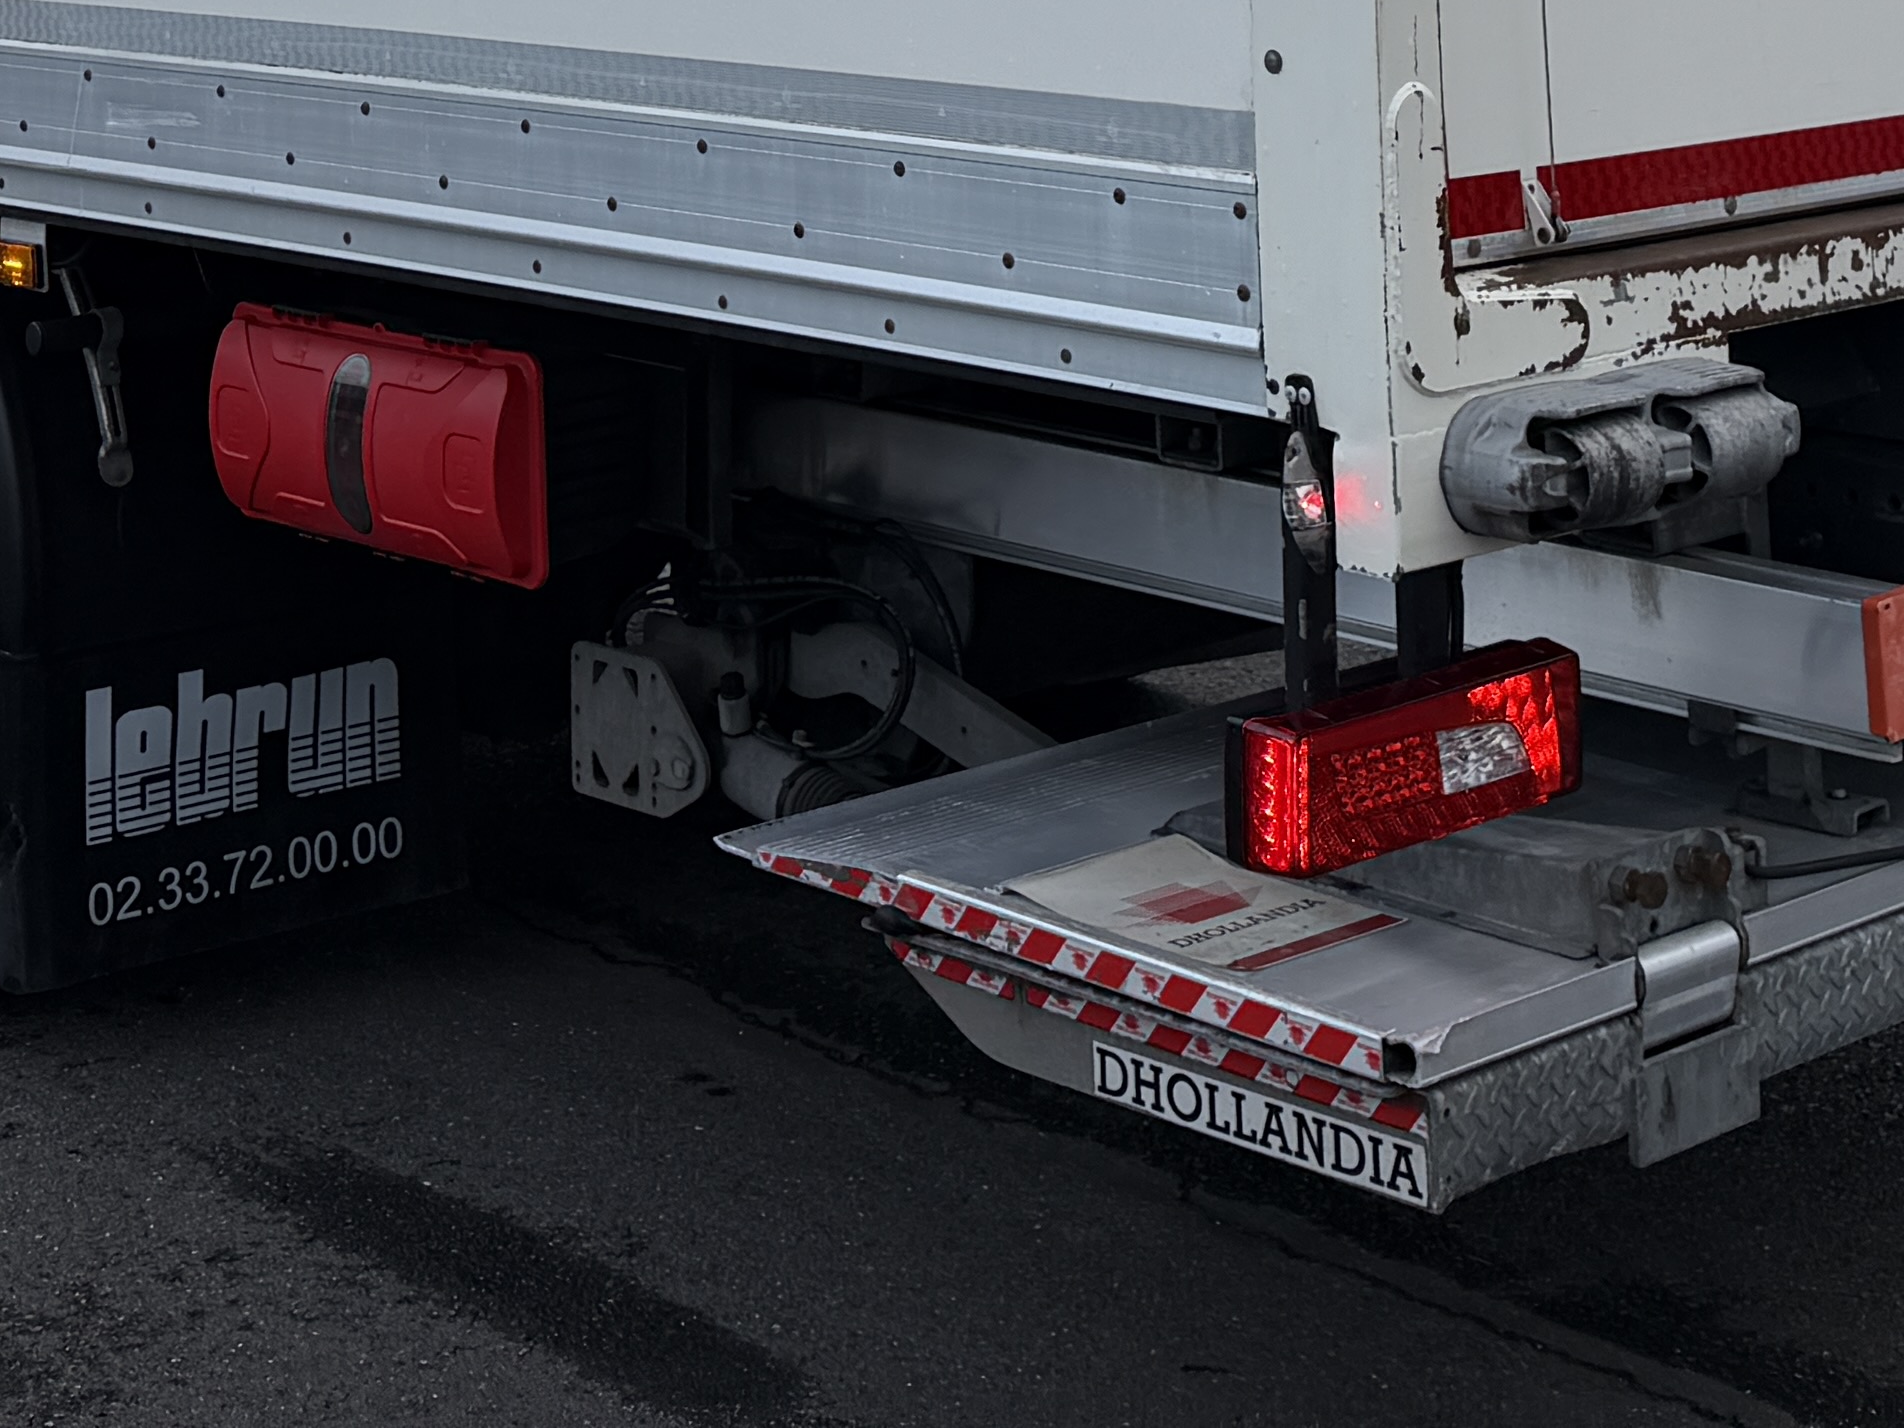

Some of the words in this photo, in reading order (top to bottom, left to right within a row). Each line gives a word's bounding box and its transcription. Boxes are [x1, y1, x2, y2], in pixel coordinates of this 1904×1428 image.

[85, 656, 401, 846] lebrun
[88, 816, 403, 926] 02.33.72.00.00
[1168, 897, 1326, 950] DHOLLANDIA
[1096, 1044, 1425, 1200] DHOLLANDIA
